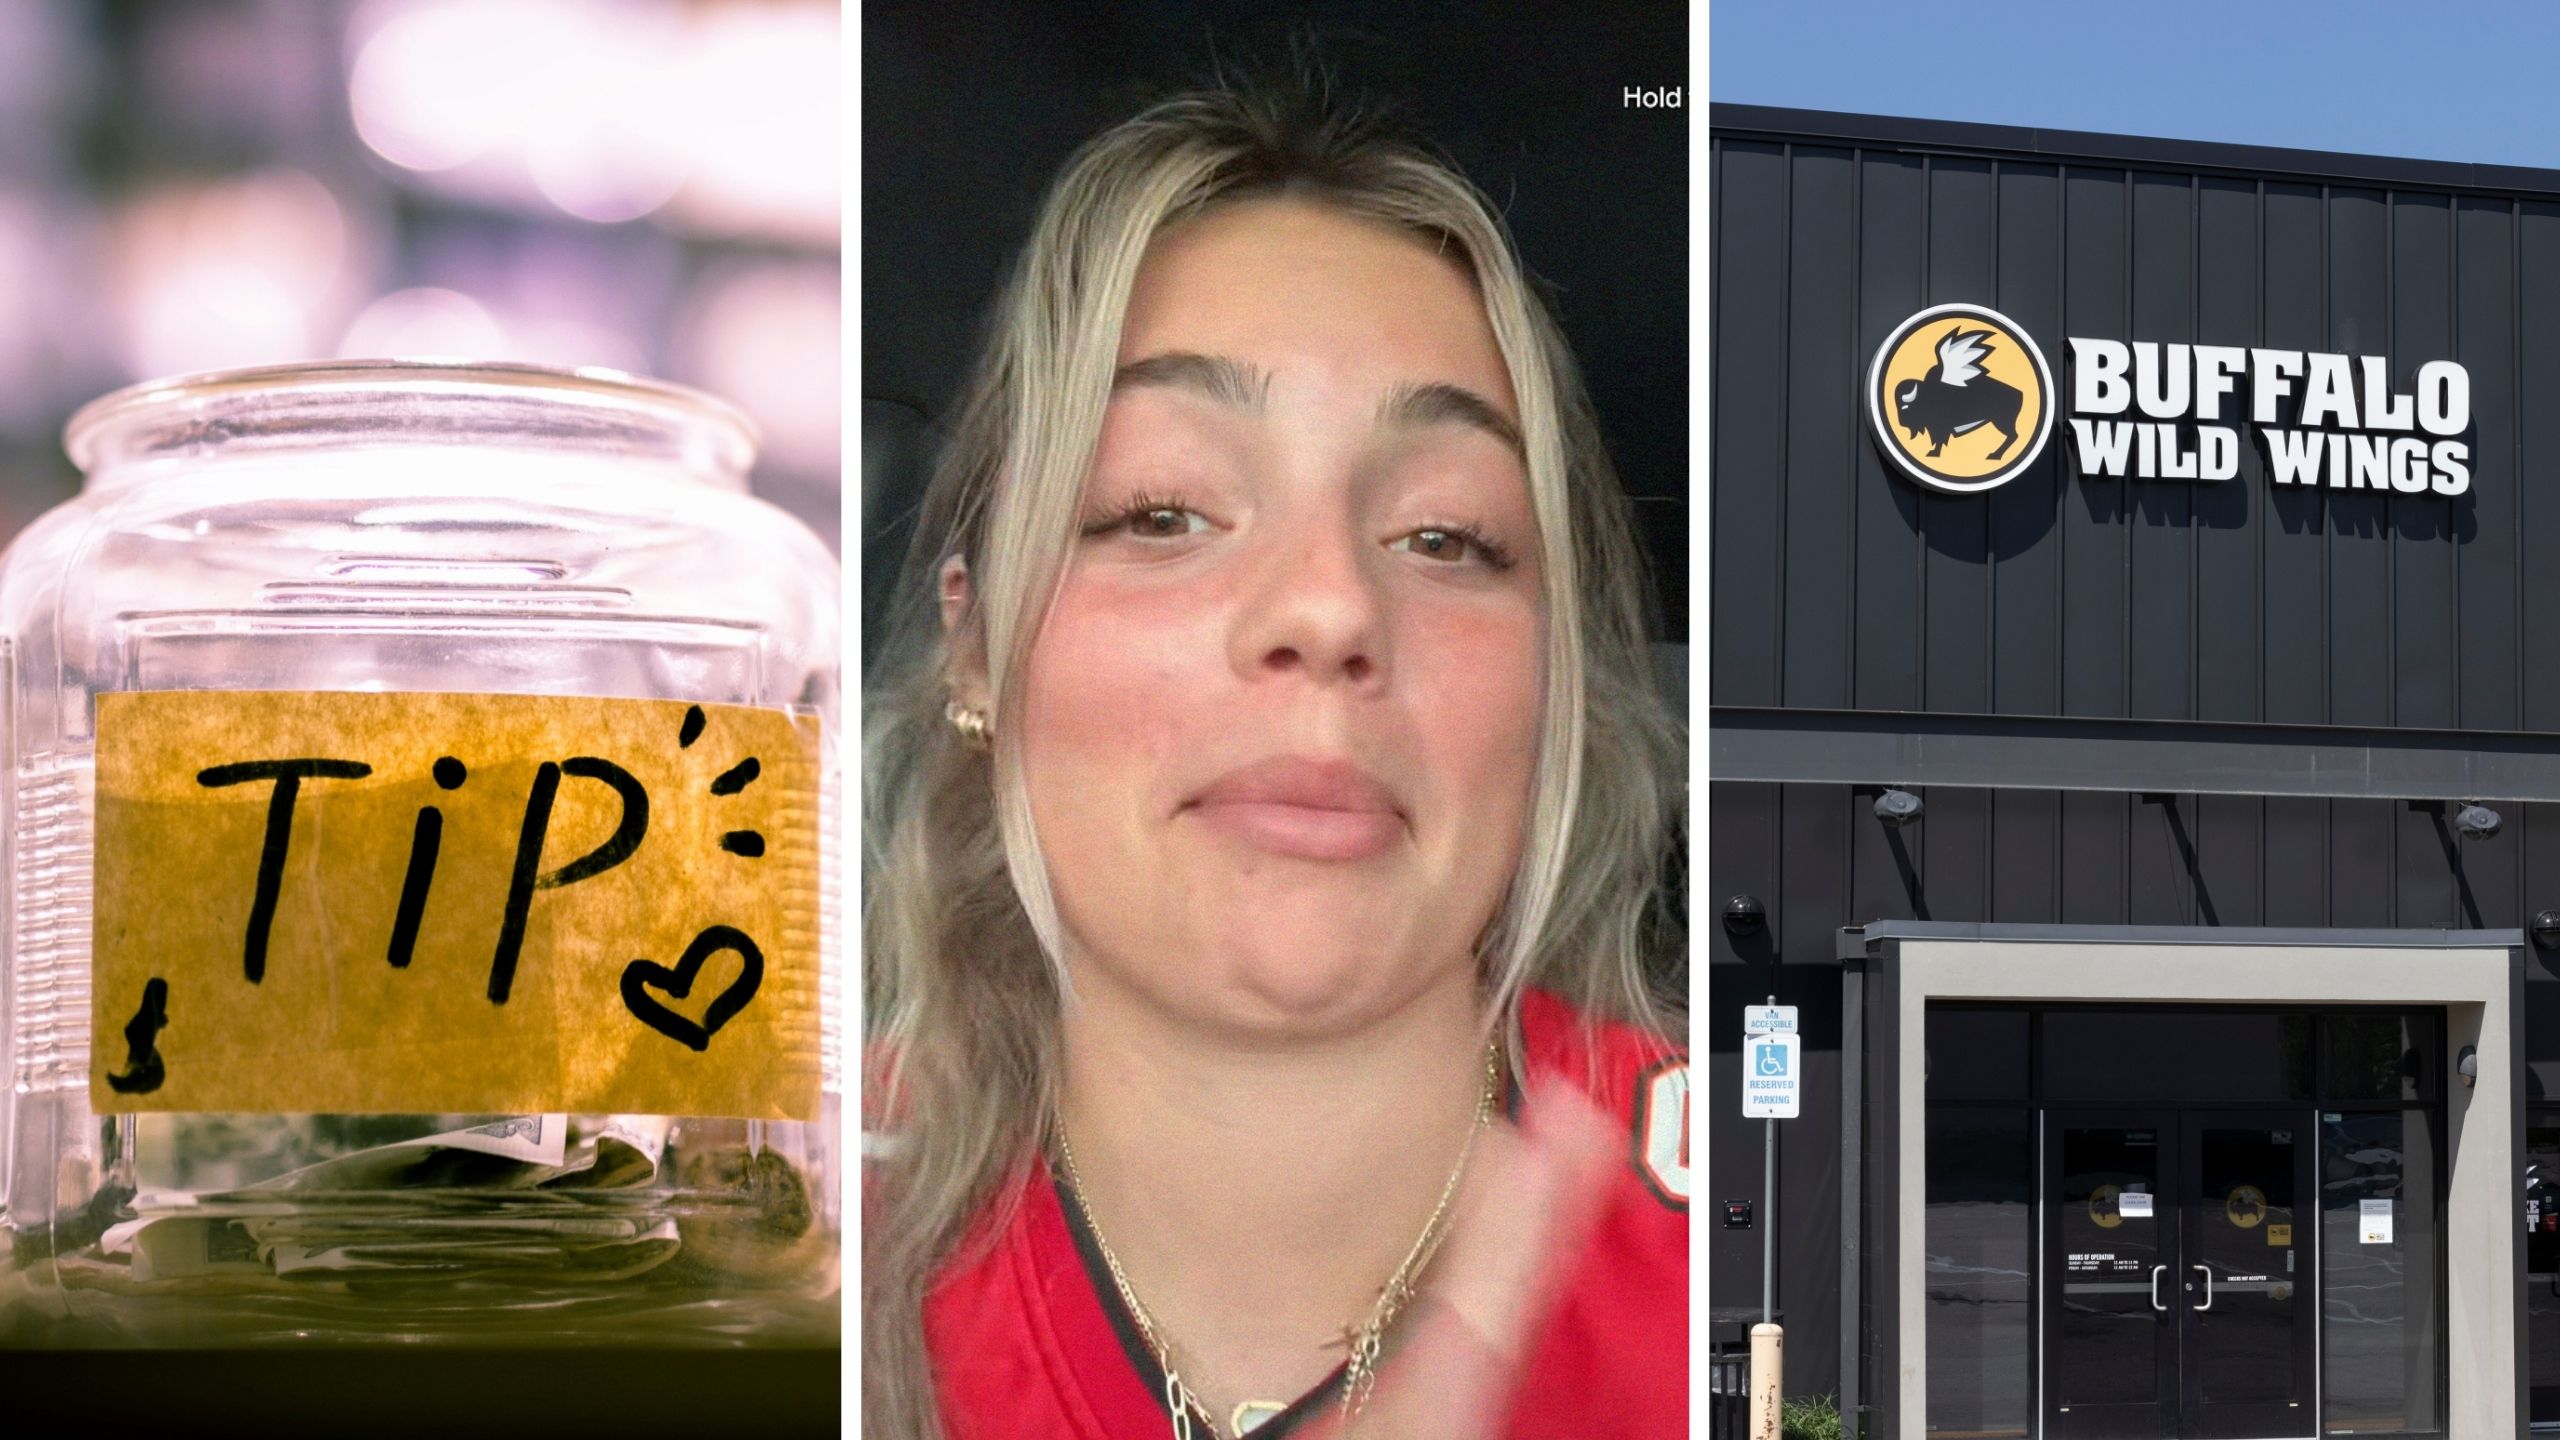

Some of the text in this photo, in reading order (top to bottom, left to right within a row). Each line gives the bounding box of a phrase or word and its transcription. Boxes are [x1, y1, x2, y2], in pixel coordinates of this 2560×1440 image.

[2065, 336, 2470, 436] BUFFALO
[2069, 418, 2470, 496] WILD WINGS
[1764, 1011, 1779, 1019] VAN
[1750, 1020, 1793, 1028] ACCESSIBLE
[1749, 1080, 1794, 1089] RESERVED
[1753, 1095, 1790, 1104] PARKING
